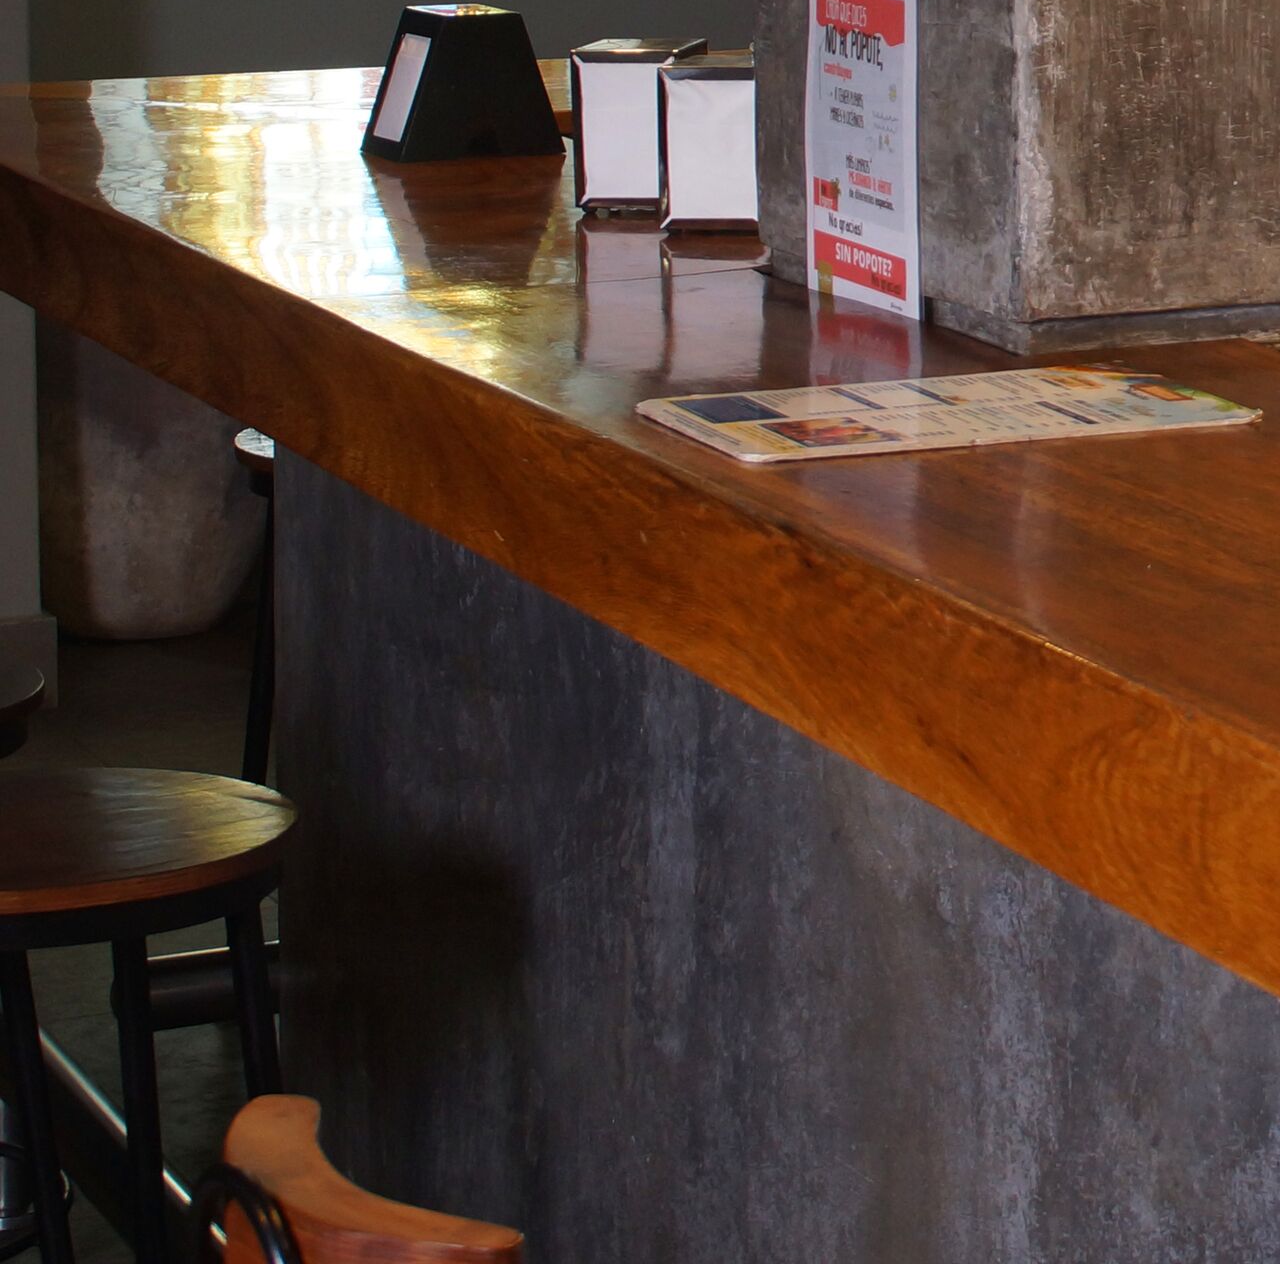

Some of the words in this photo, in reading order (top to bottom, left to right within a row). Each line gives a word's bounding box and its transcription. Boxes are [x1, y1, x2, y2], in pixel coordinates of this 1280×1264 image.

[825, 25, 838, 55] NO
[850, 29, 884, 71] POPOTE,
[828, 212, 838, 229] No
[835, 242, 851, 264] SIN
[853, 247, 893, 277] POPOTE?
